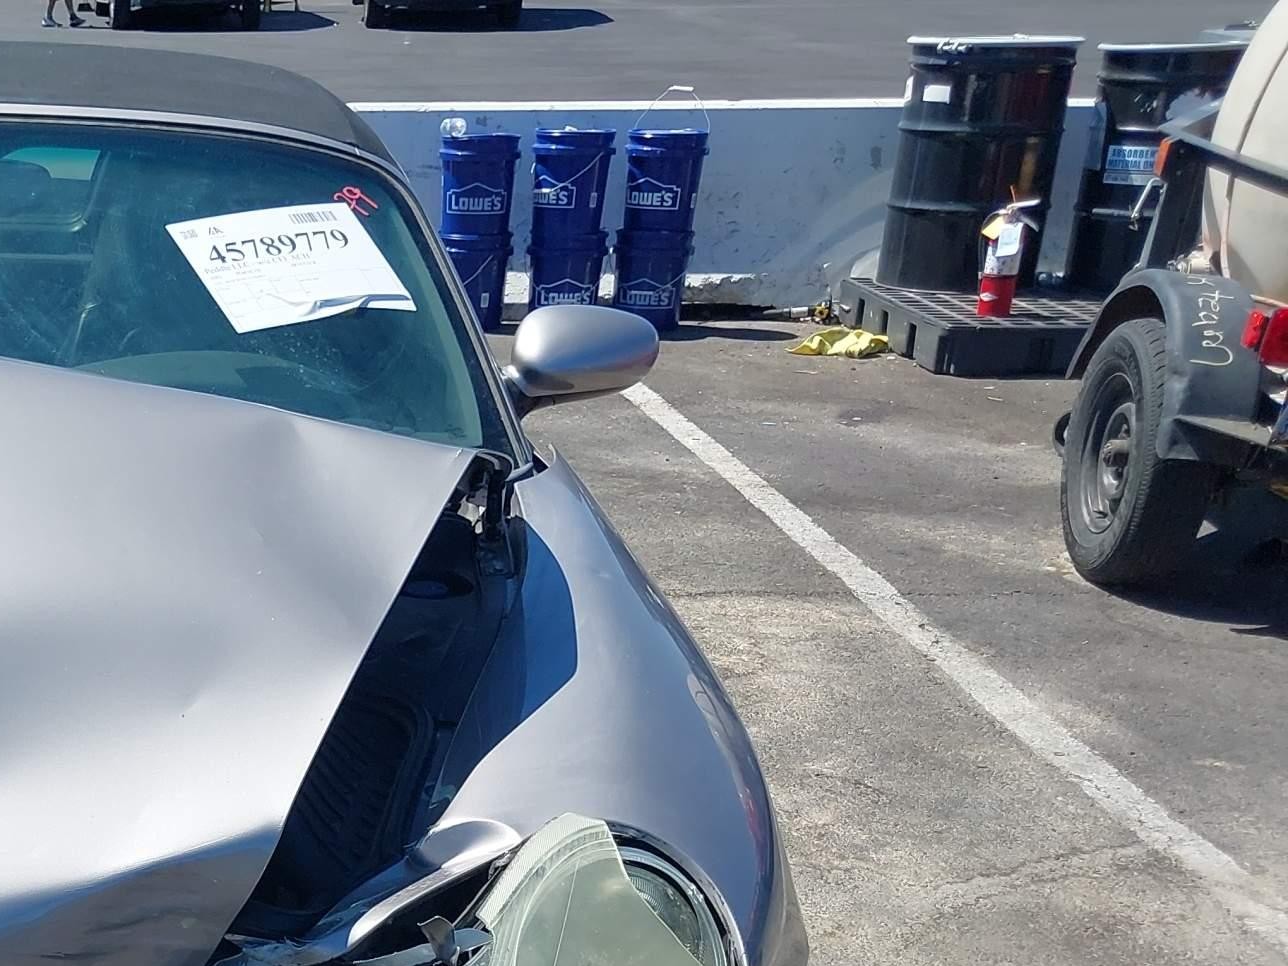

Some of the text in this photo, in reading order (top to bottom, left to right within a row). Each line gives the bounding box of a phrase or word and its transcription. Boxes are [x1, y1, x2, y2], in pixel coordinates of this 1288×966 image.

[1112, 149, 1156, 158] ABSORBEN
[451, 194, 503, 212] LOWE'S
[533, 191, 568, 206] OWE'S
[209, 228, 350, 264] 45789779
